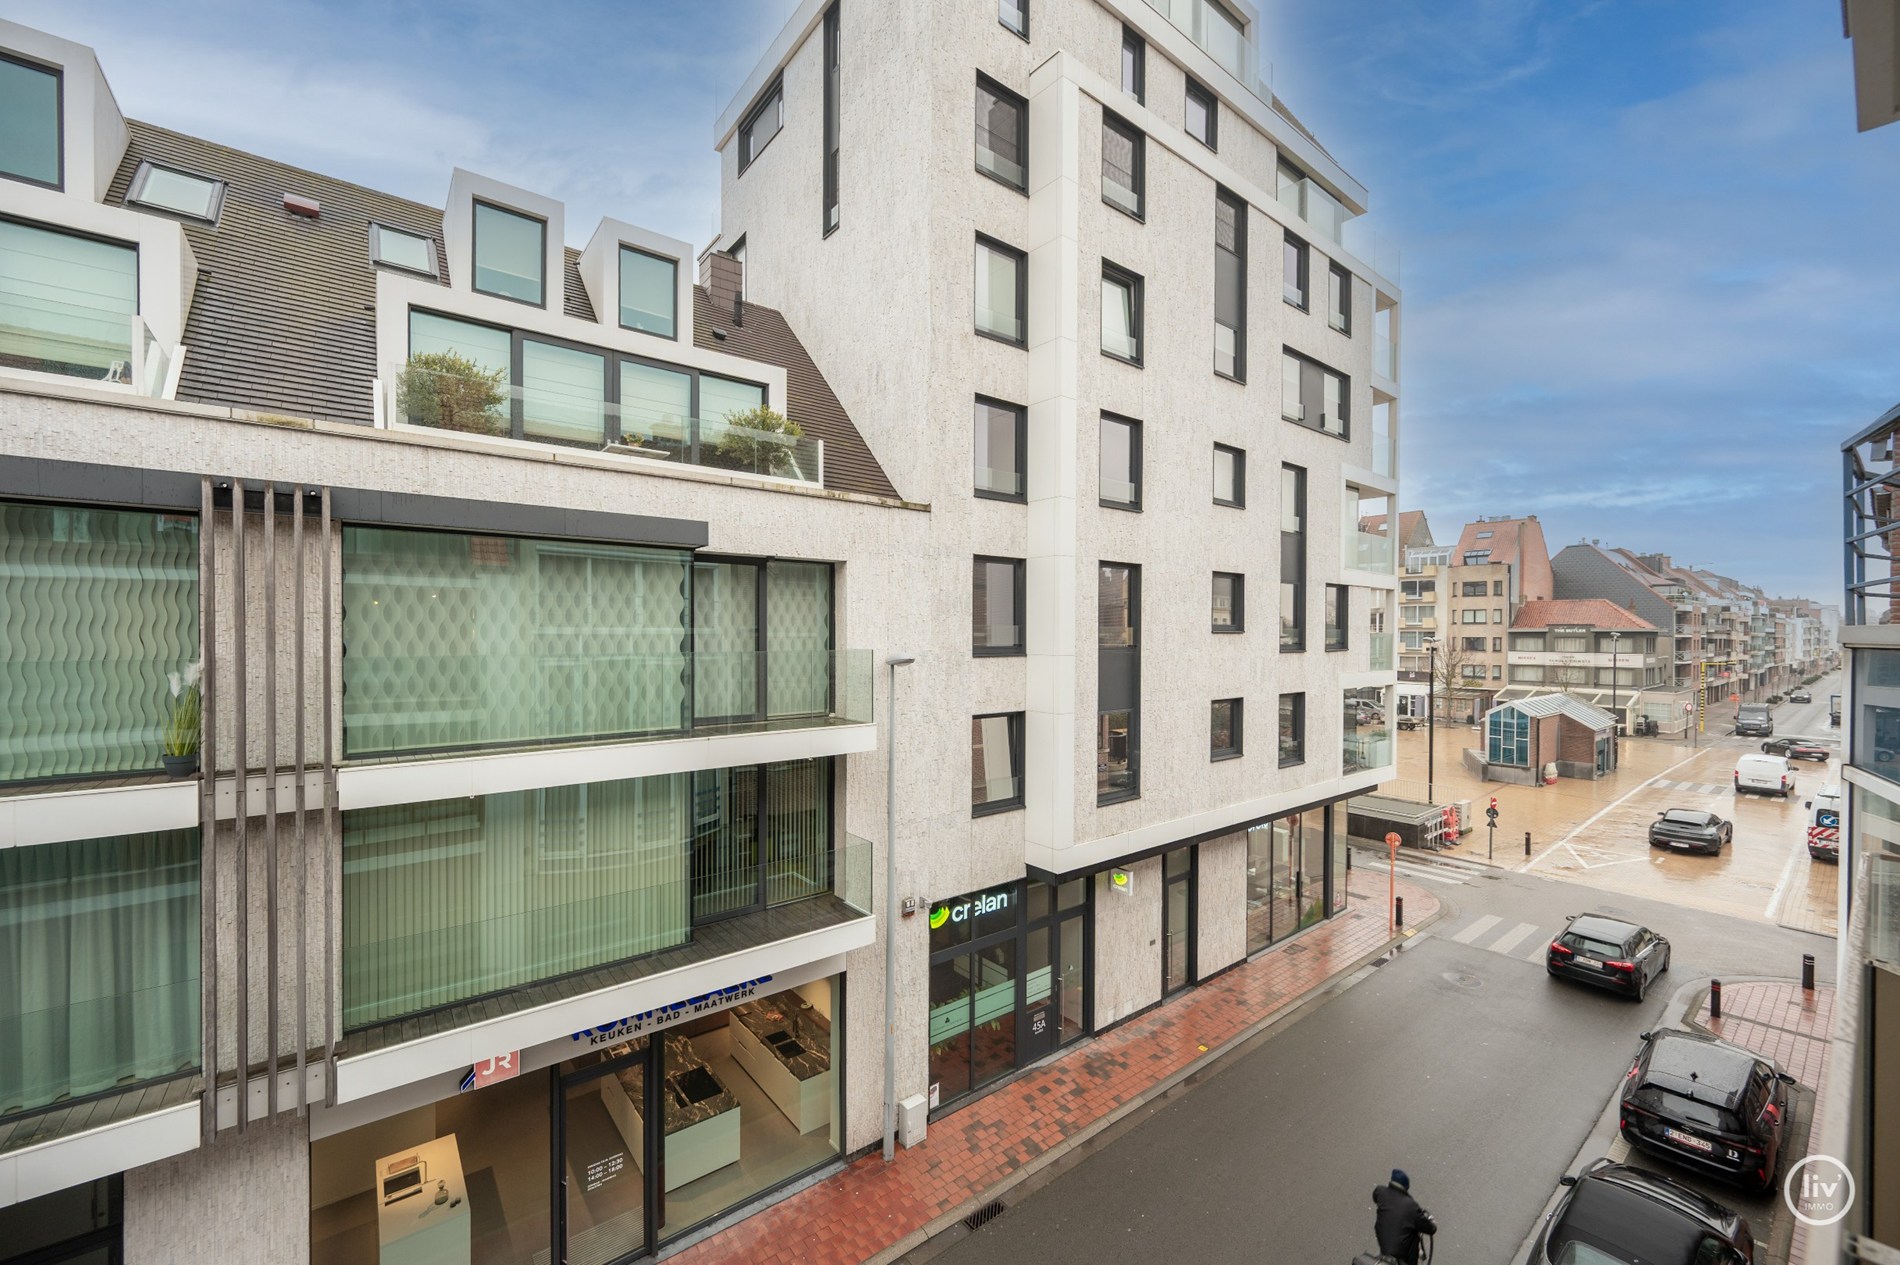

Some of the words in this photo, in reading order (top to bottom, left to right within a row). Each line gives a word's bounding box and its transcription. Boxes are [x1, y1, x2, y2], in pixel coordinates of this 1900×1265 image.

[951, 893, 1008, 922] crelan
[590, 1022, 642, 1046] KEUKEN
[656, 1012, 681, 1025] BAD
[694, 987, 755, 1013] MAATWERK
[1032, 1019, 1046, 1031] 45A
[587, 1165, 603, 1175] 10:00
